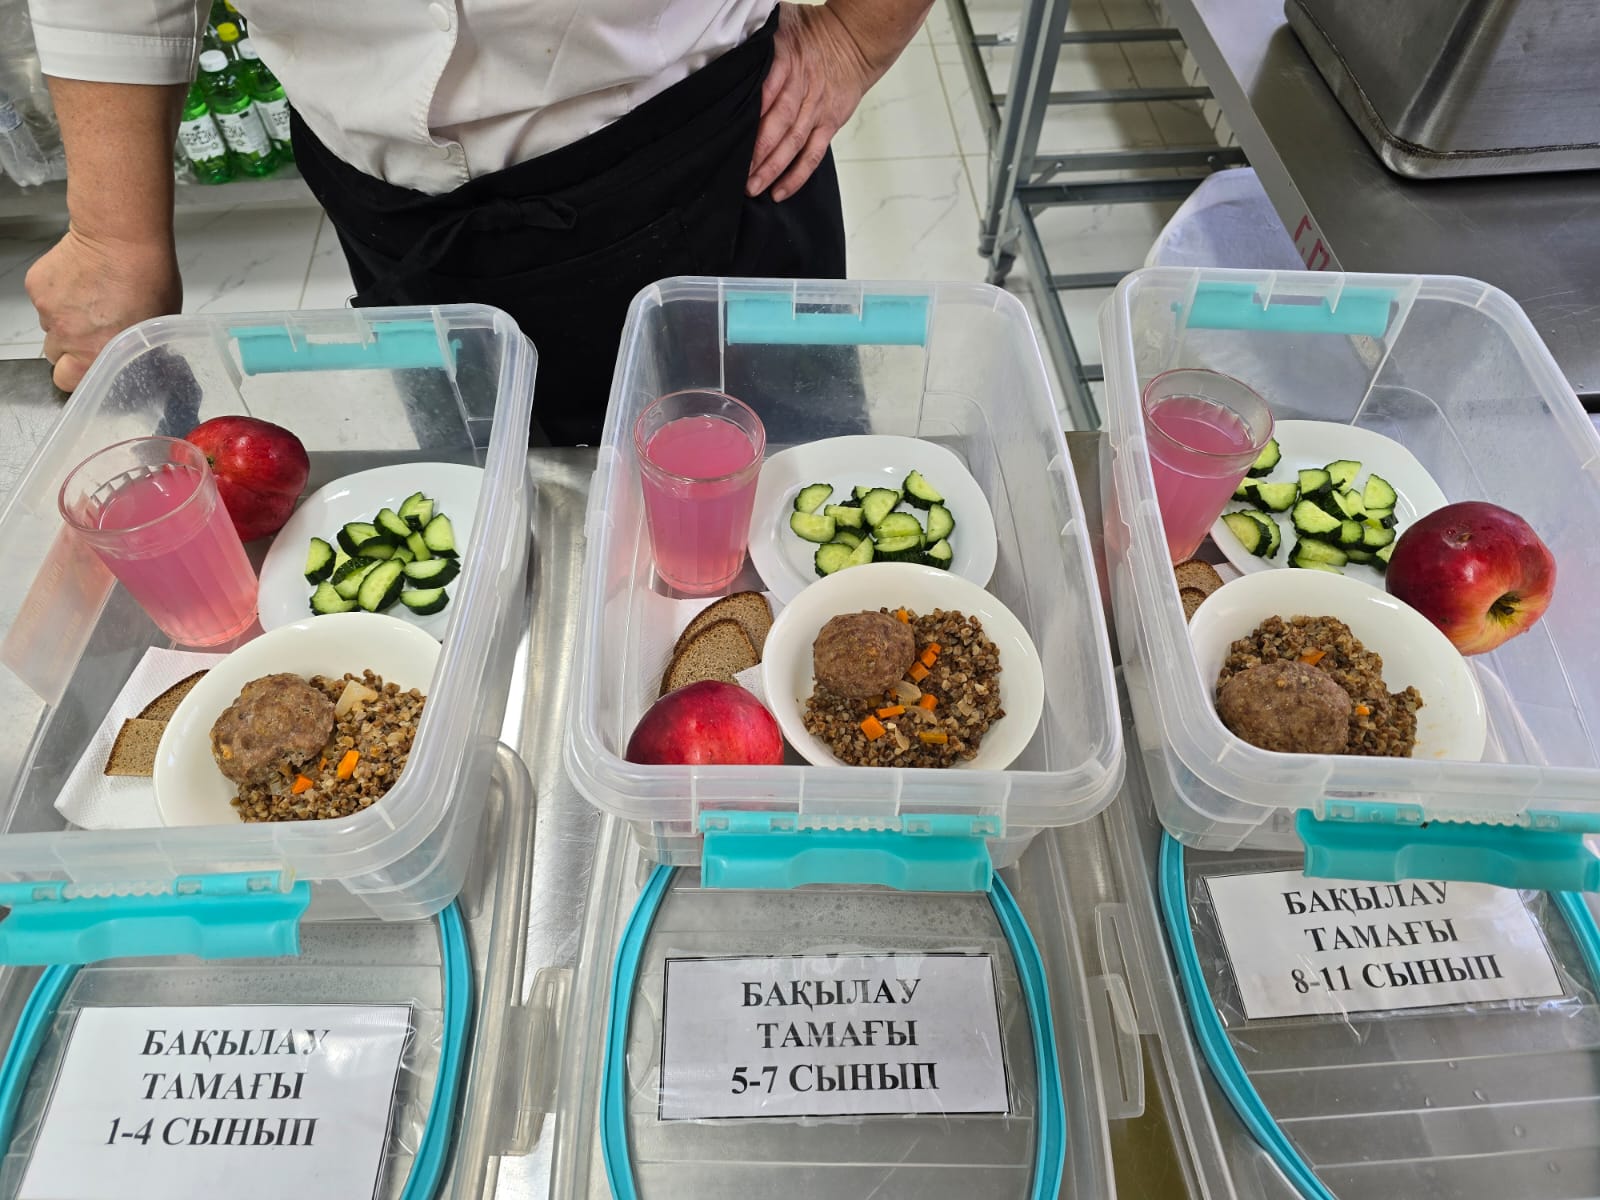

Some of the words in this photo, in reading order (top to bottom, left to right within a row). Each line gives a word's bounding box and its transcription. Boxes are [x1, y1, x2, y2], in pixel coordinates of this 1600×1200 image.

[1284, 882, 1448, 917] БАҚЫЛАУ
[1304, 919, 1459, 952] ТАМАҒЫ
[1291, 966, 1353, 994] 8-11
[1362, 954, 1504, 988] СЫНЫП
[741, 978, 921, 1010] БАҚЫЛАУ
[139, 1029, 330, 1061] БАҚЫЛАУ
[757, 1020, 918, 1048] ТАМАҒЫ
[141, 1072, 308, 1100] ТАМАҒЫ
[731, 1066, 778, 1094] 5-7
[789, 1062, 939, 1093] СЫНЫП
[104, 1117, 151, 1145] 1-4
[162, 1117, 319, 1146] СЫНЫП
